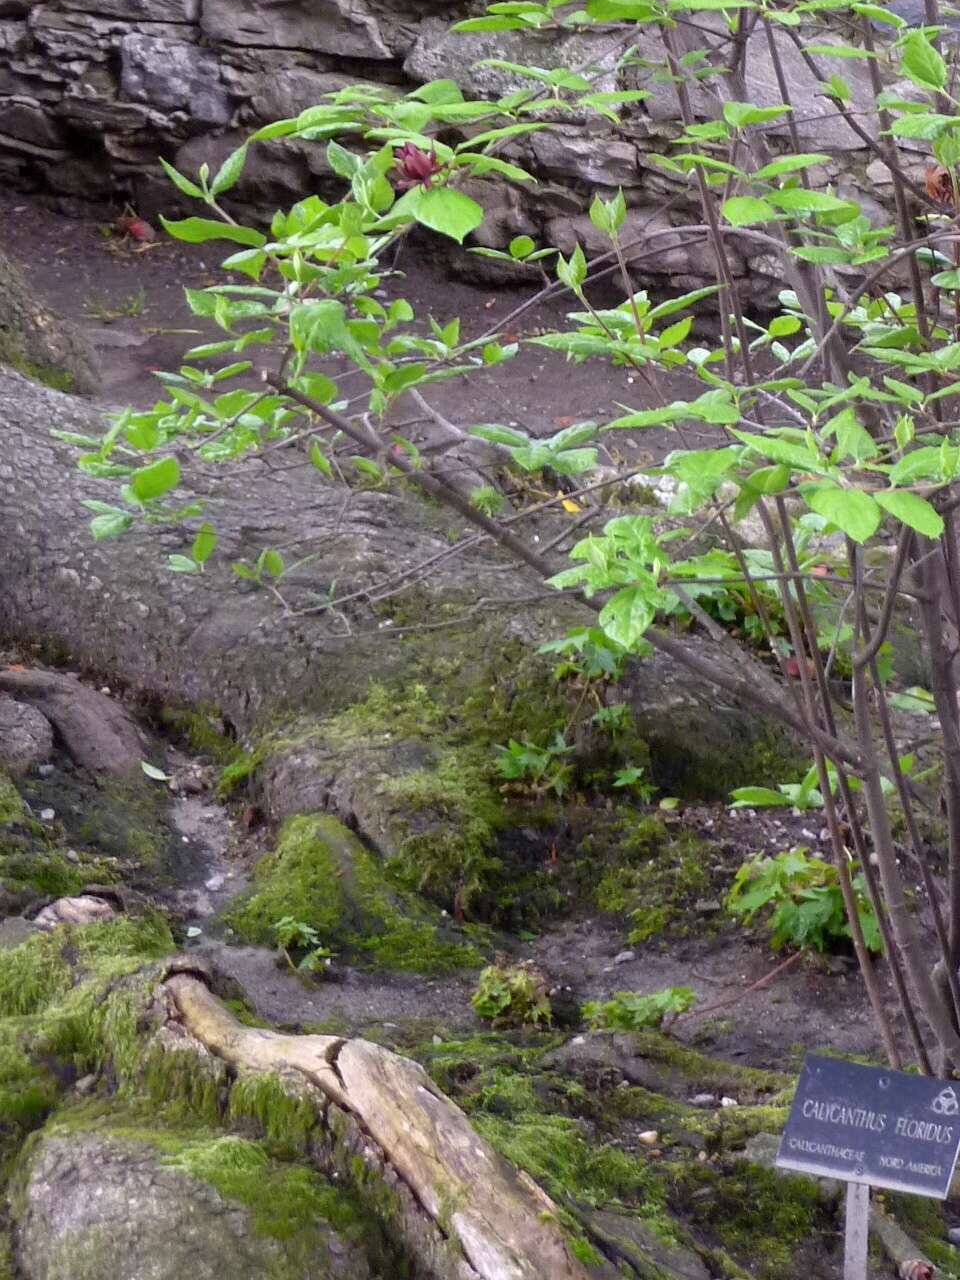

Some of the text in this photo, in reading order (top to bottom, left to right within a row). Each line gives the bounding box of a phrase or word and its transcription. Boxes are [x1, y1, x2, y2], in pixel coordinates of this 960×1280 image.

[802, 1099, 953, 1144] CALYCANTHUS FLORIDUS
[879, 1156, 905, 1169] NORD
[907, 1162, 942, 1177] AMERICA
